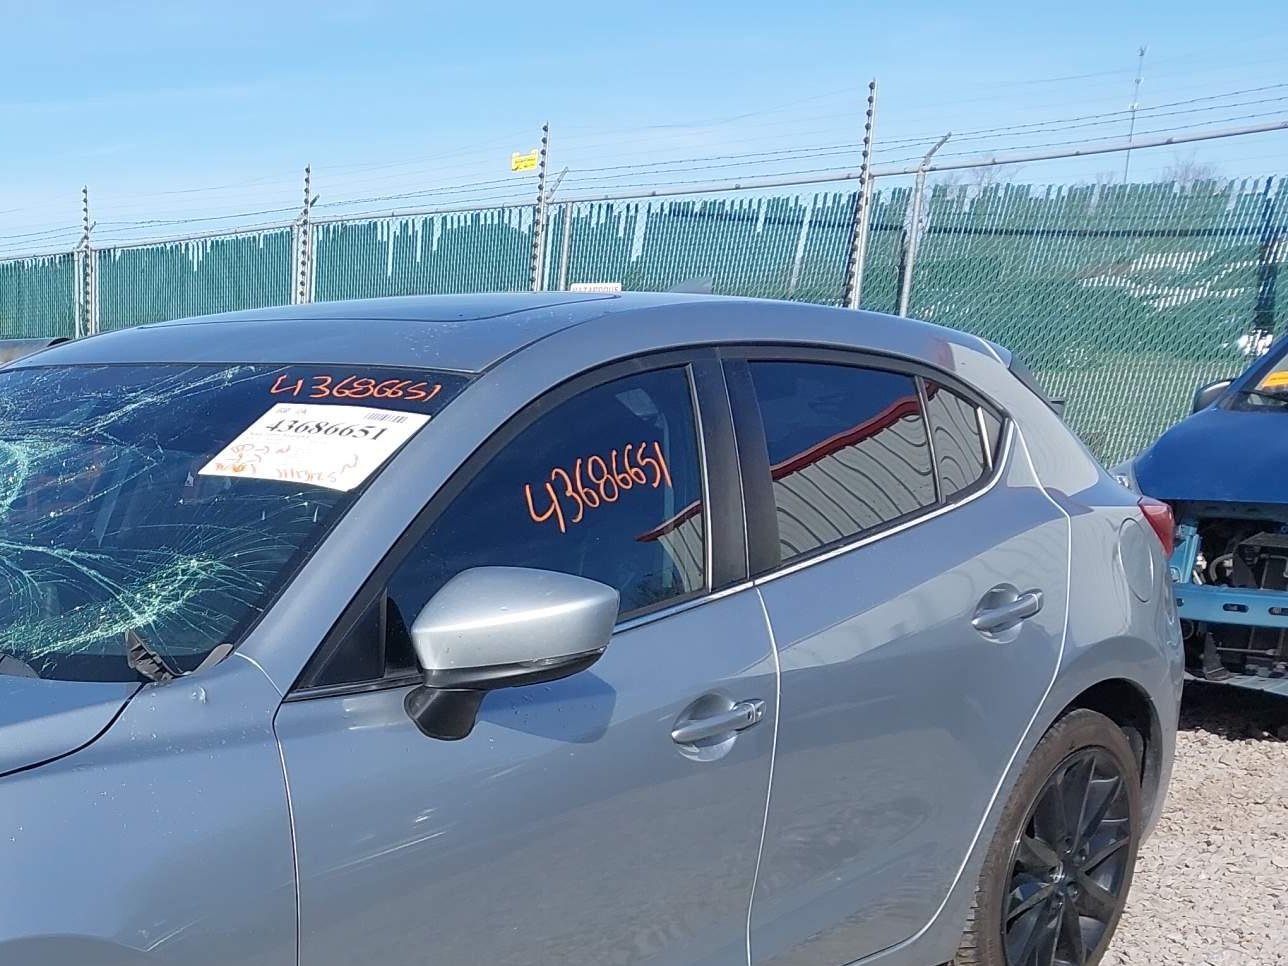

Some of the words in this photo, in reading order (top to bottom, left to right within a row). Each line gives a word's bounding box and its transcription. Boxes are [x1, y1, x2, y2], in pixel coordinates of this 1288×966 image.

[269, 374, 444, 402] 43686651
[265, 418, 389, 441] 43686651
[523, 441, 673, 534] 43686651
